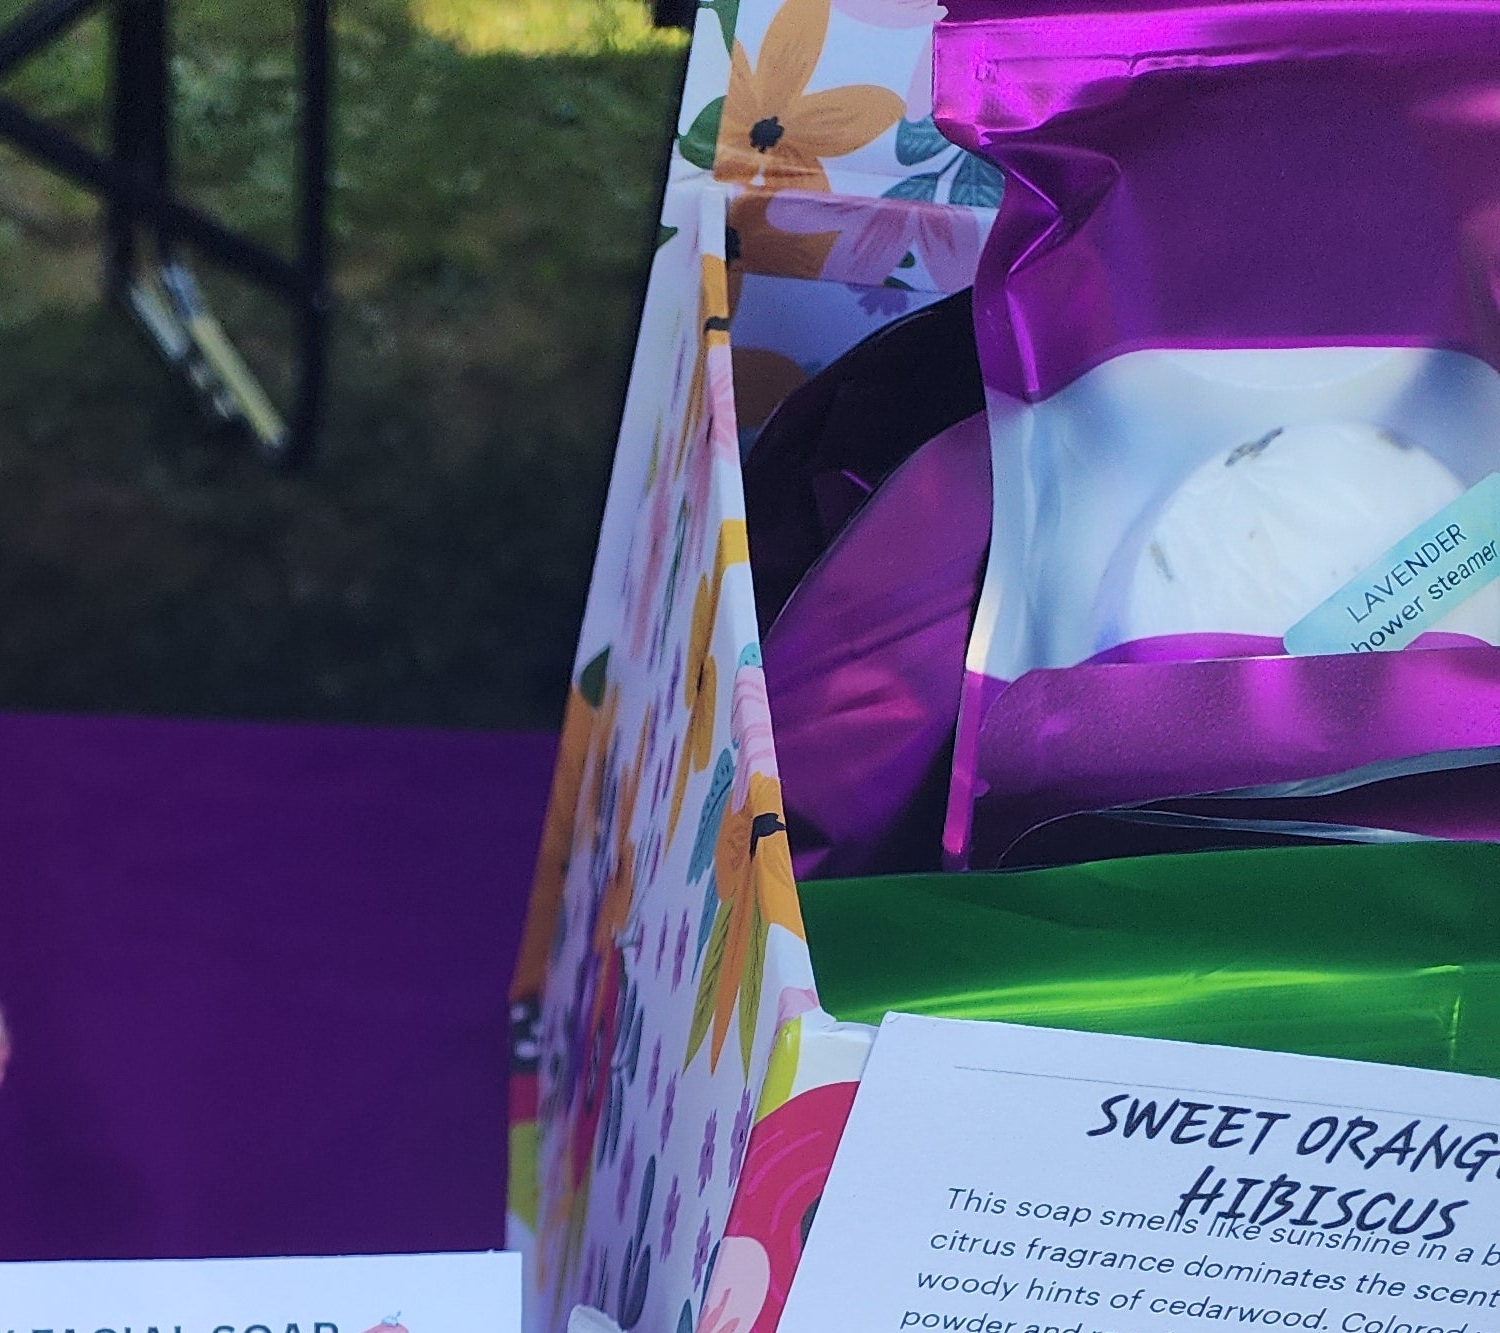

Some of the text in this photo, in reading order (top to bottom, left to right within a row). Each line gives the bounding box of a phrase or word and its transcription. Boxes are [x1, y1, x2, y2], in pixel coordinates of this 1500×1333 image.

[1346, 523, 1467, 623] LAVENDER
[1350, 539, 1499, 653] hower steamer
[1085, 1093, 1500, 1182] SWEET ORANG
[948, 1187, 1008, 1215] This
[1015, 1201, 1092, 1228] soap
[1100, 1207, 1198, 1236] smells
[1208, 1216, 1261, 1240] like
[1270, 1228, 1411, 1256] sunshine
[1416, 1242, 1448, 1261] in
[1454, 1247, 1475, 1264] a
[1178, 1165, 1469, 1242] HIBISCUS
[917, 1272, 1020, 1302] woody
[1025, 1277, 1101, 1307] hints
[1109, 1288, 1146, 1311] of
[1148, 1295, 1329, 1331] cedarwood.
[930, 1229, 1500, 1308] citrus fragrance dominates the scent
